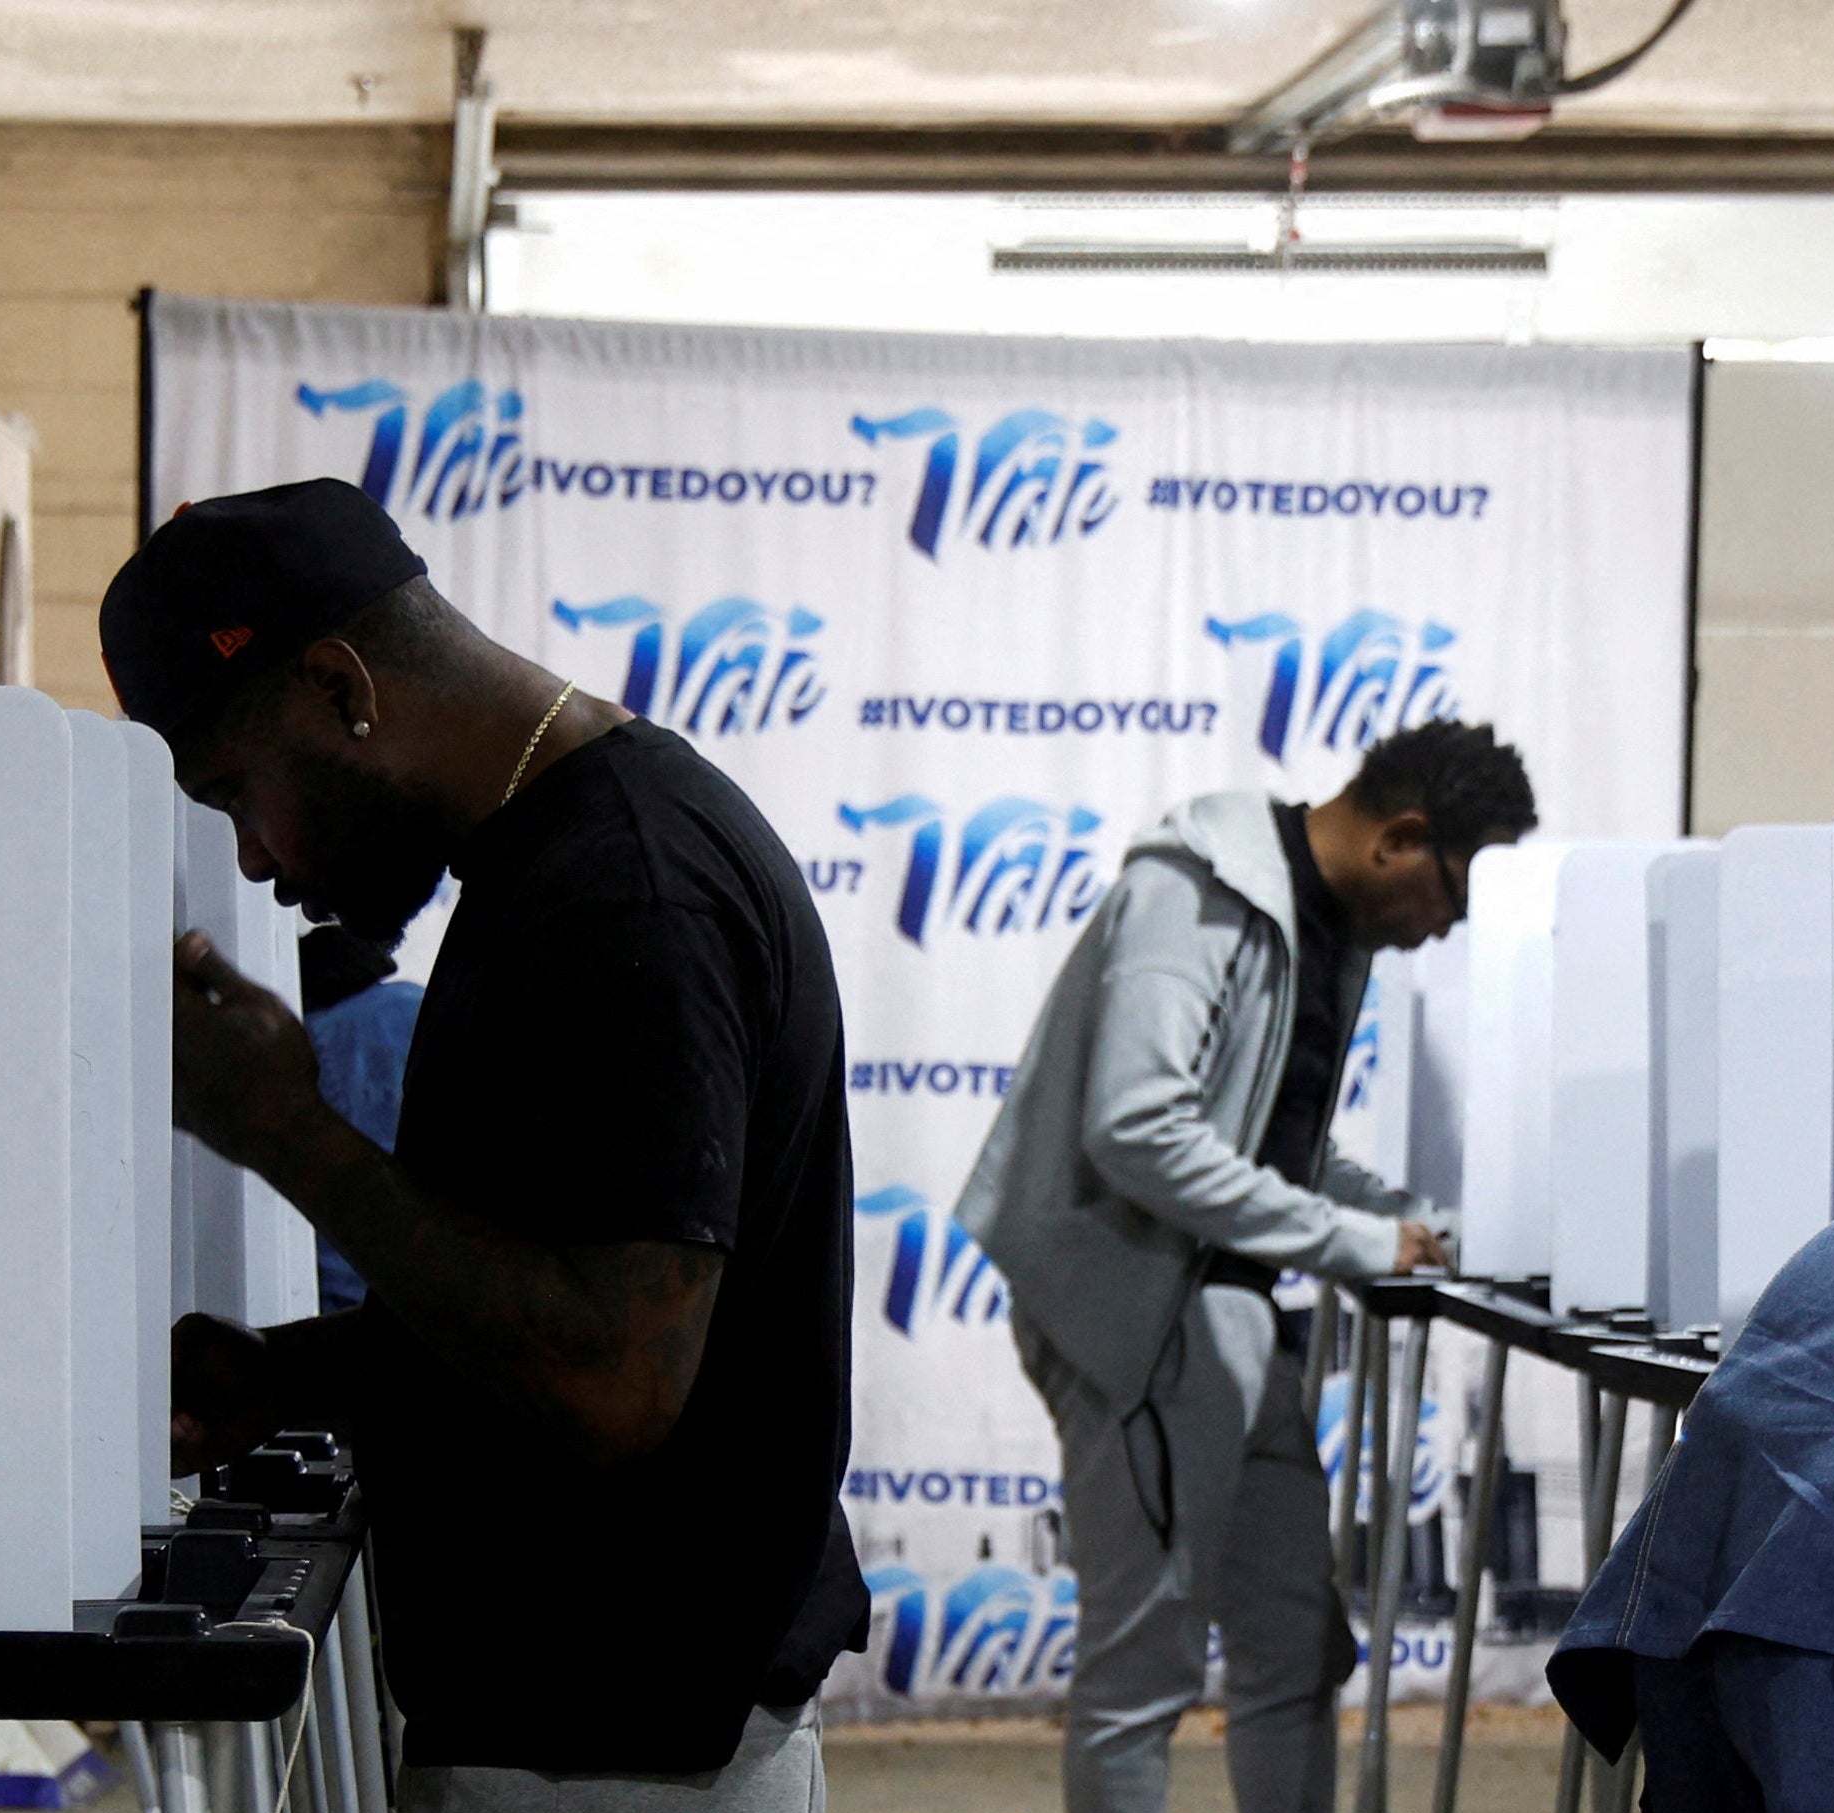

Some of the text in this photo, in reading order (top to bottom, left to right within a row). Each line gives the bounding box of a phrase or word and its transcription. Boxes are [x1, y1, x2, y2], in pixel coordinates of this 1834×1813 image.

[850, 406, 1120, 566] Vote
[1147, 477, 1490, 519] #IVOTEDOYOU?
[552, 595, 827, 736] Vote
[859, 696, 1220, 735] #IVOTEDOYOU?
[838, 793, 1107, 952] Vote
